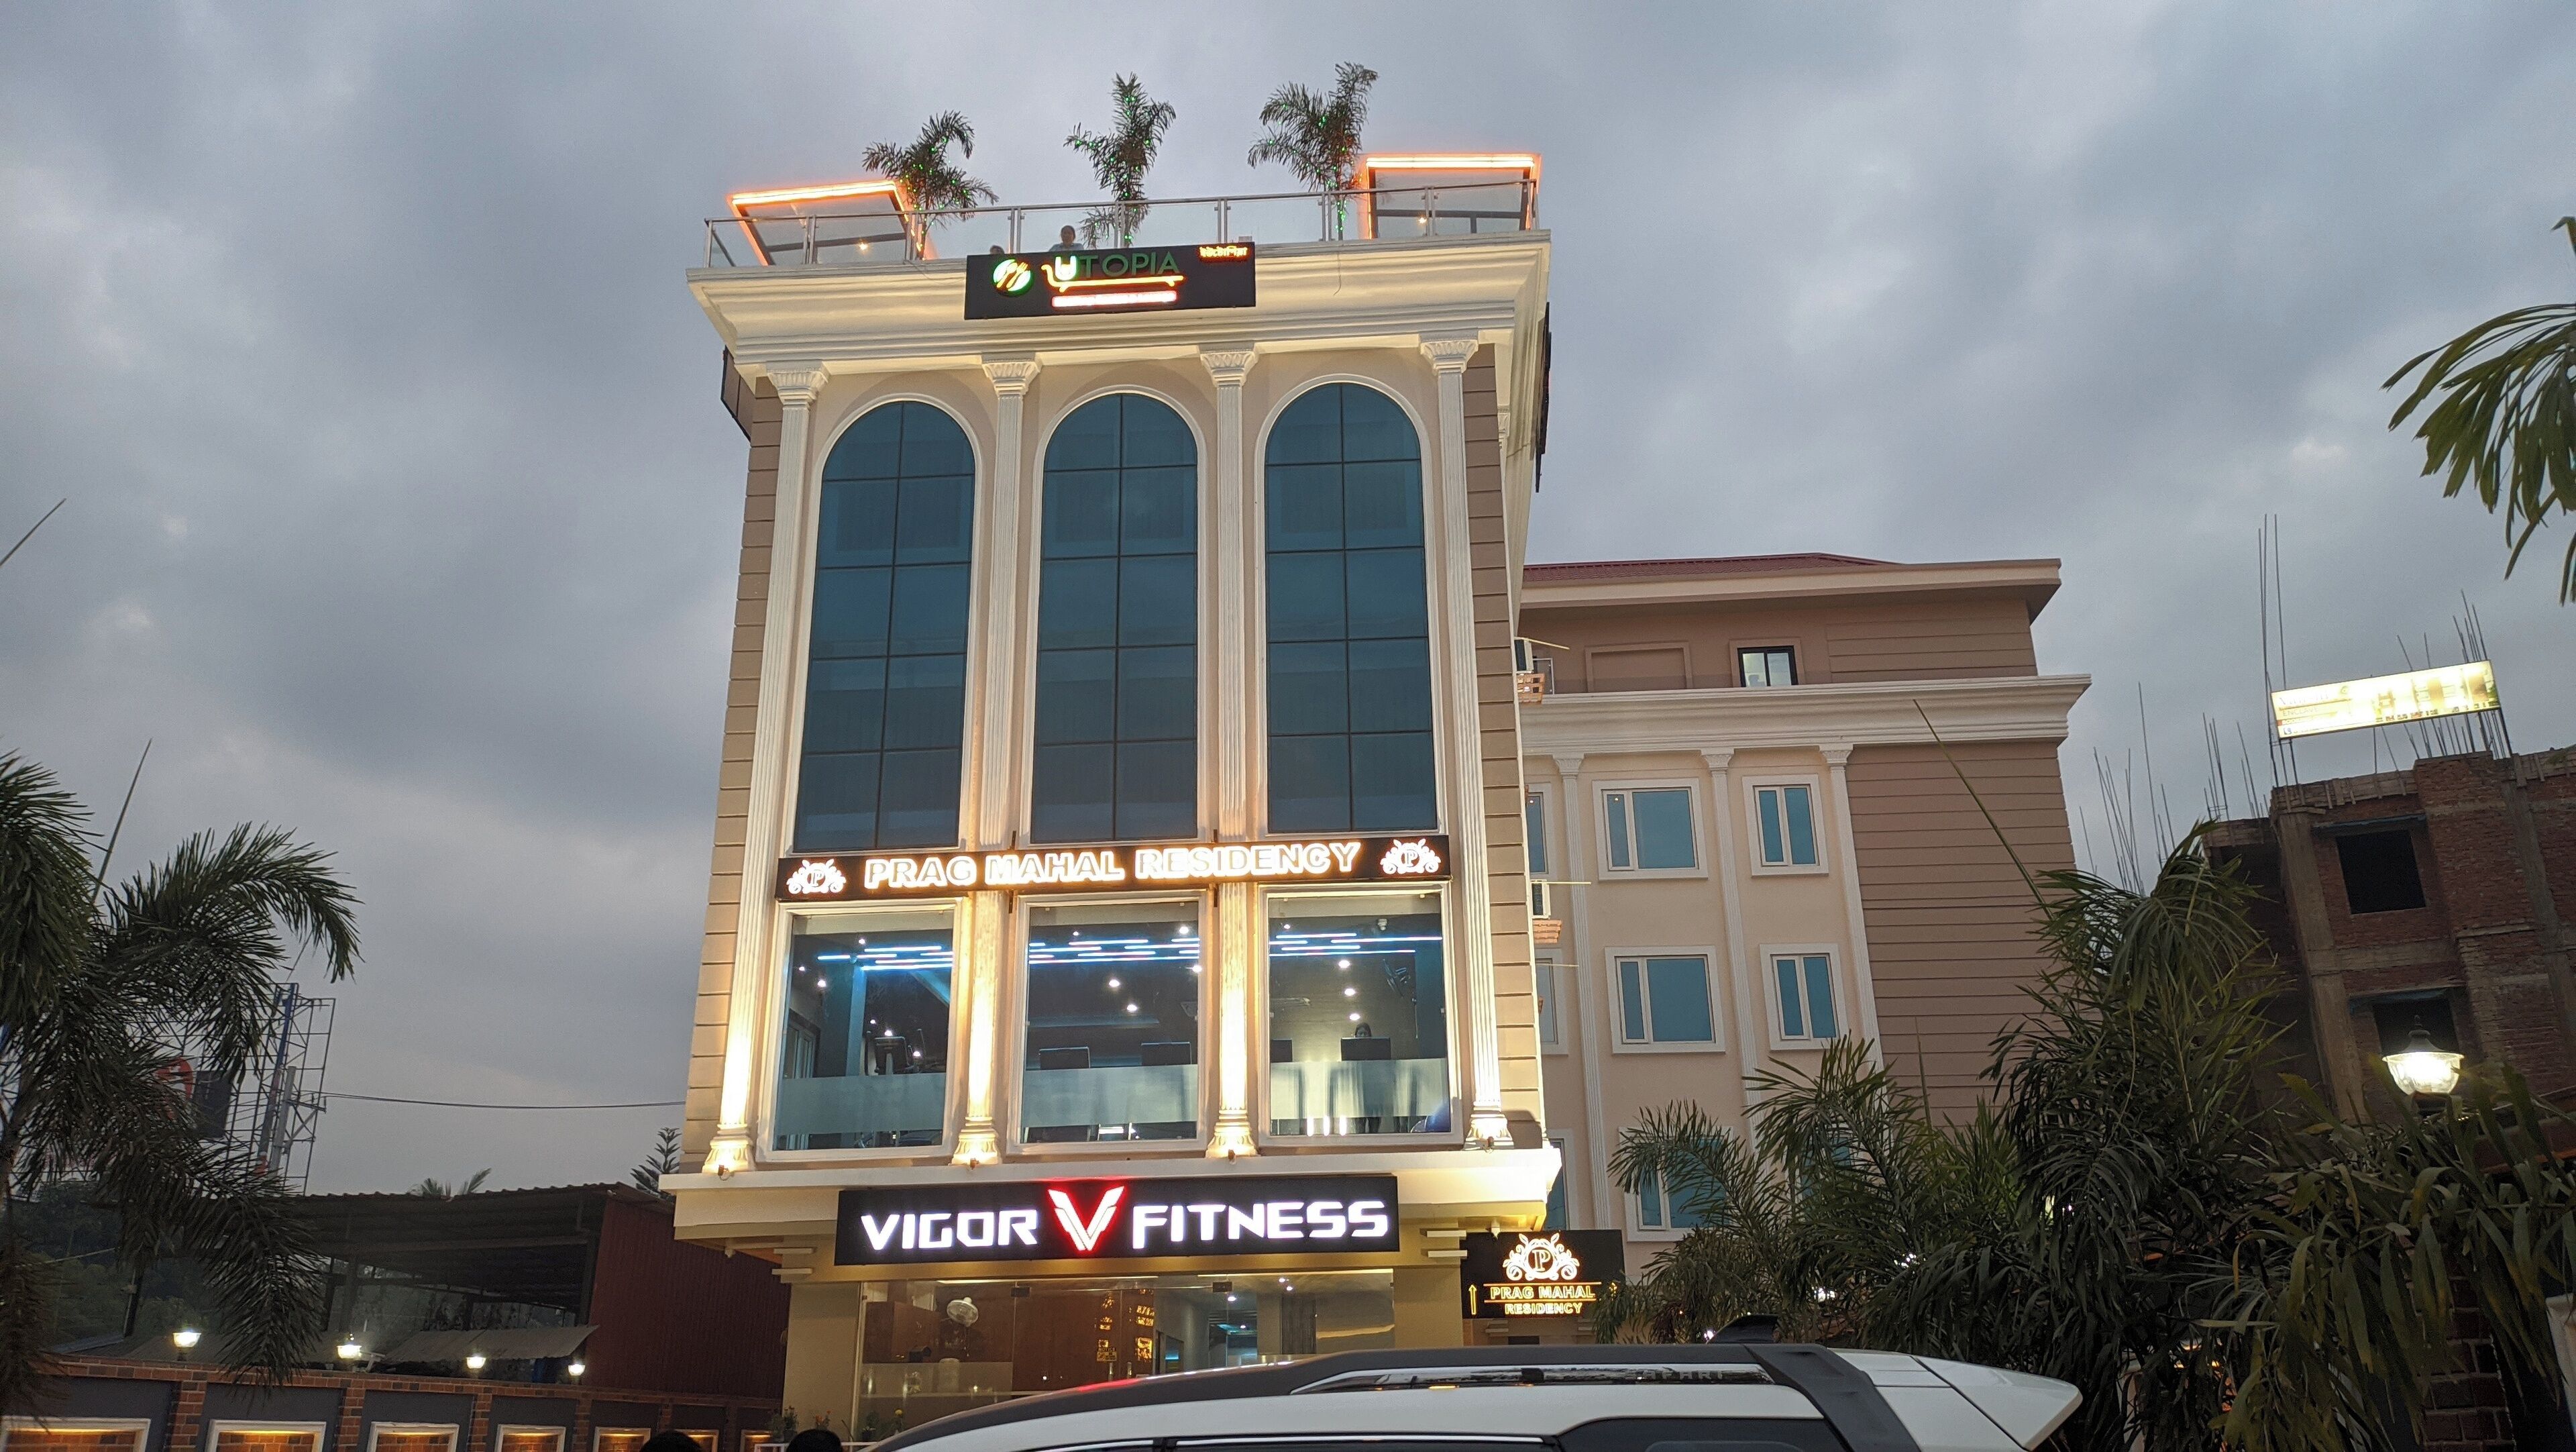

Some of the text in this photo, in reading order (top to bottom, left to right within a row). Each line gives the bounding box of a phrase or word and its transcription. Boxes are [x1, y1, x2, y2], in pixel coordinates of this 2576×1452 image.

[1055, 251, 1180, 280] UTOPIA
[864, 842, 1361, 890] PRAG MAHAL RESIDENCY
[861, 1186, 1389, 1251] VIGOR V FITNESS
[1532, 1249, 1551, 1272] P
[1490, 1286, 1595, 1299] PRAG MAHAL
[1505, 1302, 1582, 1314] RESIDENCY
